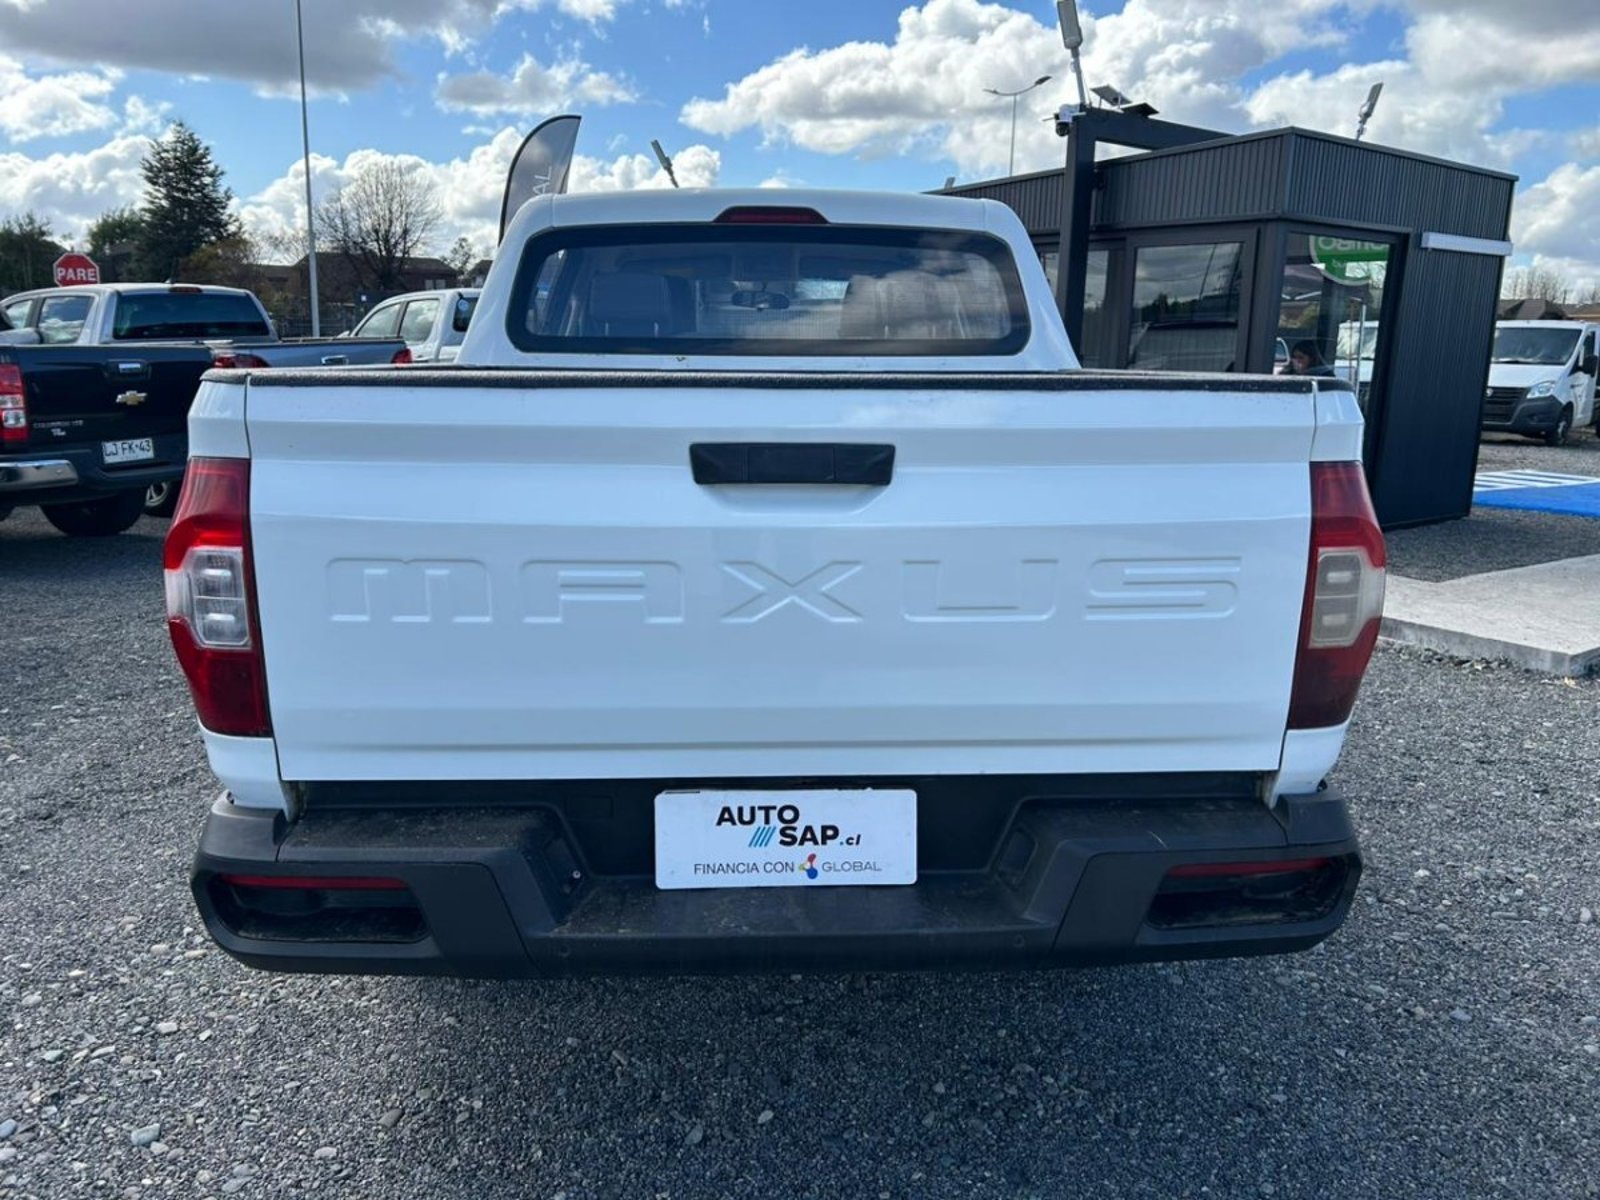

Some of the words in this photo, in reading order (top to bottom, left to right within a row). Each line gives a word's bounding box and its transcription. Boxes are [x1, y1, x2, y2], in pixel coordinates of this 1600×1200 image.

[56, 267, 97, 281] PARE
[326, 556, 1243, 623] MAXUS
[715, 805, 800, 826] AUTO
[694, 862, 760, 876] FINANCIA
[763, 861, 795, 875] CON
[821, 860, 883, 873] GLOBAL
